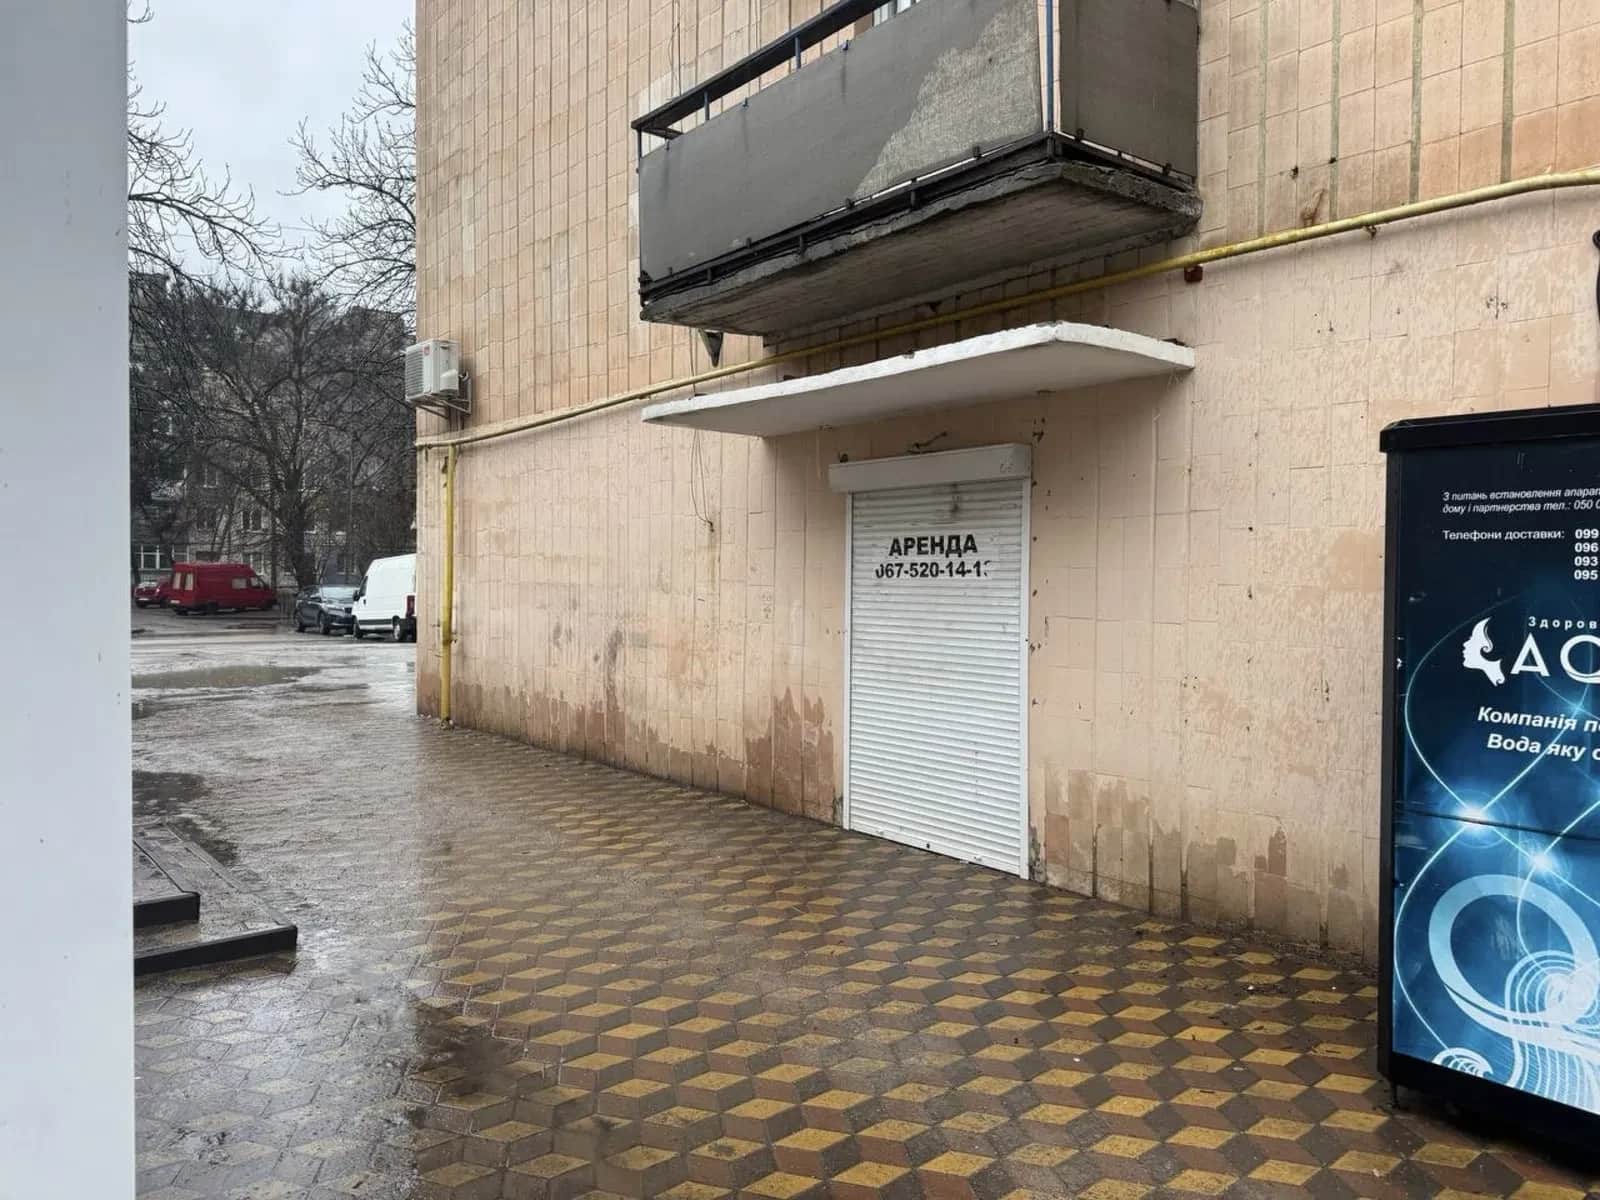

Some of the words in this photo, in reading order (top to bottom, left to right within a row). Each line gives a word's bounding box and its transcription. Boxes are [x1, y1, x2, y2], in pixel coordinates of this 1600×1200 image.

[1442, 491, 1450, 501] З
[1452, 492, 1488, 501] питань
[1489, 489, 1561, 500] встановлення
[1442, 503, 1466, 515] дому
[1473, 502, 1541, 514] партнерства
[1573, 499, 1594, 510] 050
[1442, 530, 1502, 541] Телефони
[1504, 529, 1566, 540] доставки:
[1574, 528, 1600, 539] 099
[889, 533, 978, 558] АРЕНДА
[1574, 542, 1600, 553] 096
[1574, 555, 1599, 567] 093
[1573, 569, 1599, 580] 095
[1527, 615, 1598, 631] Здоров
[1477, 706, 1578, 731] Компанія
[1583, 719, 1600, 733] п
[1487, 732, 1542, 754] Вода
[1545, 743, 1587, 762] яку
